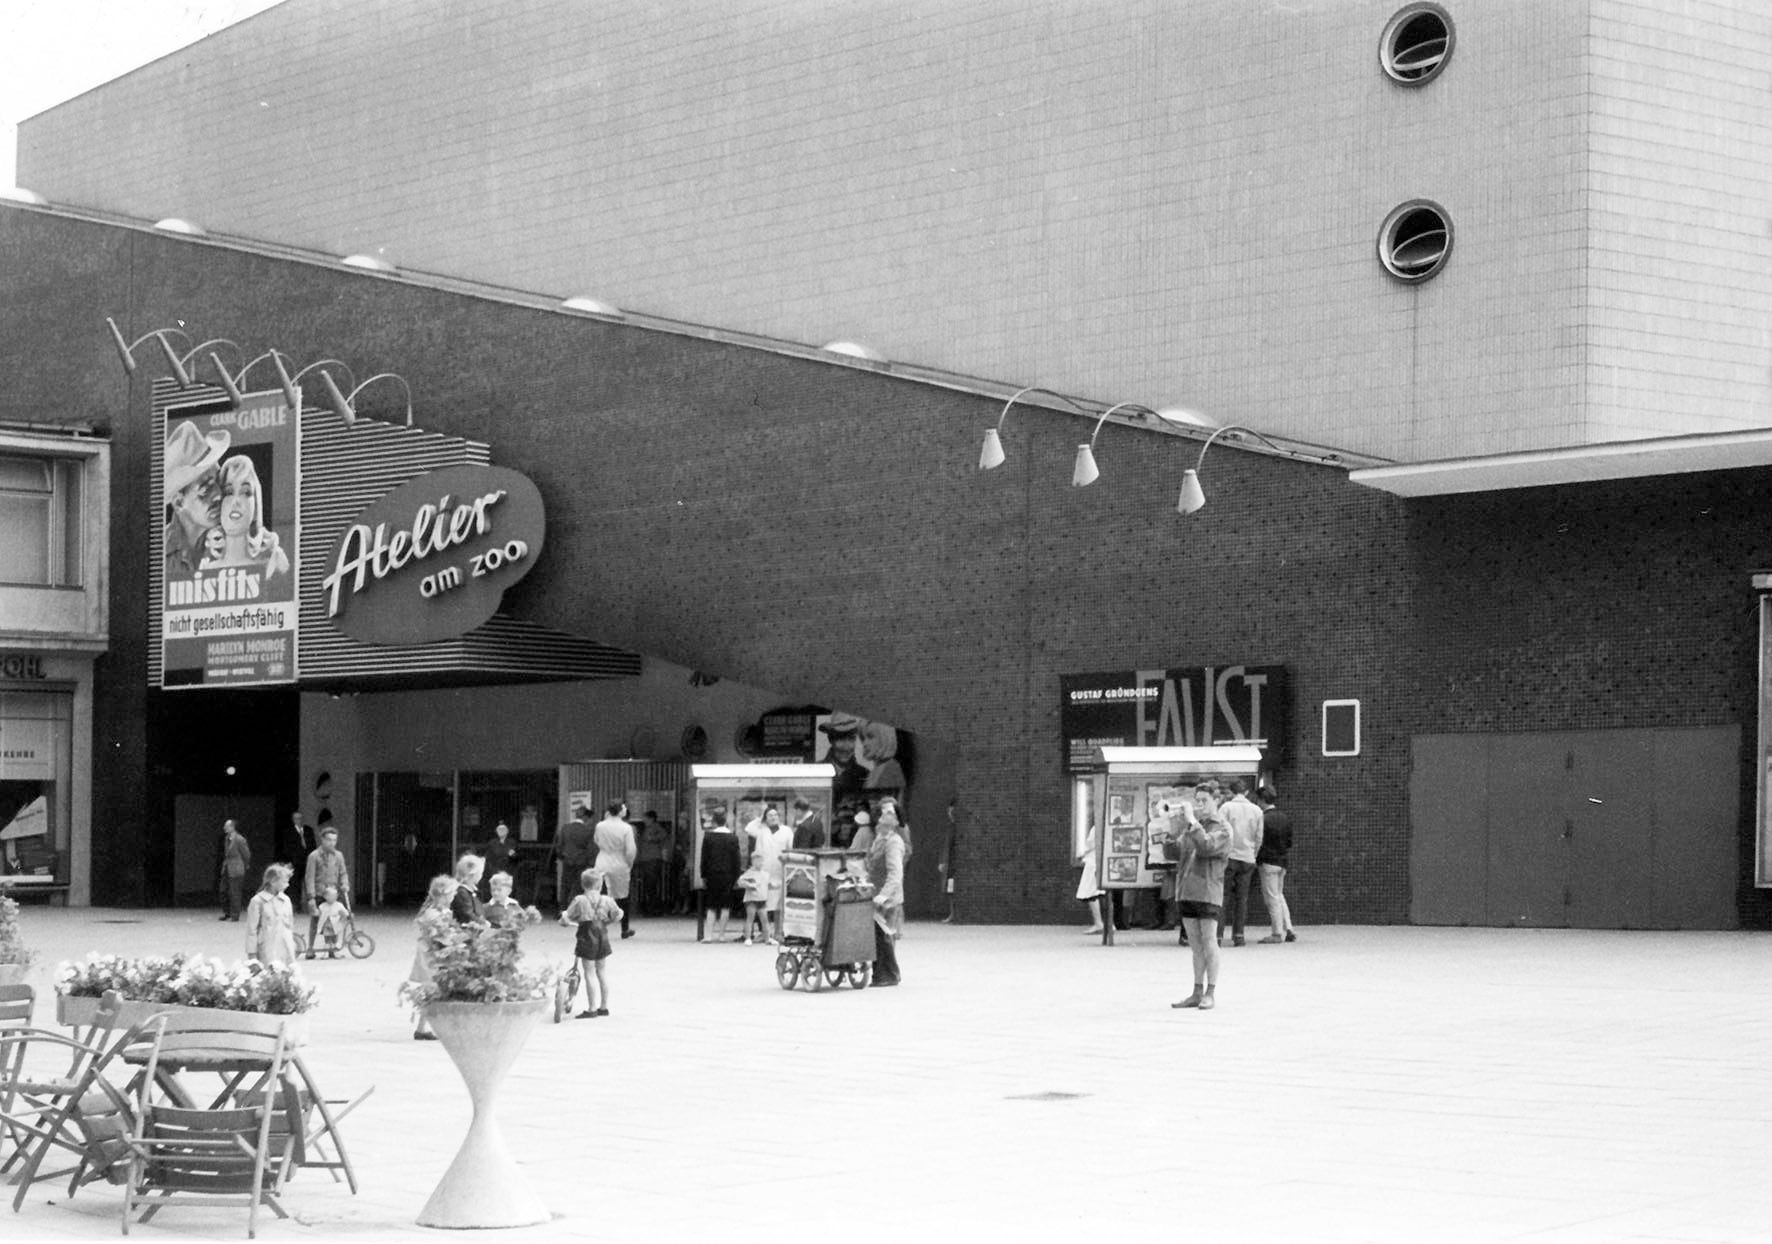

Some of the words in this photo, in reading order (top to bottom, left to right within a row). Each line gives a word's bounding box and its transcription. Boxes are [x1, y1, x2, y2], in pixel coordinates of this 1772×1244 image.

[238, 405, 287, 430] GABLE
[322, 490, 507, 618] Atelier
[420, 566, 463, 598] am
[469, 540, 528, 577] zoo
[169, 568, 261, 606] misfits
[169, 613, 191, 634] nicht
[193, 607, 285, 636] gesellschaftsfähig
[246, 637, 287, 653] MONROE
[1070, 689, 1103, 700] GUSTAF
[1135, 665, 1268, 747] FAUST
